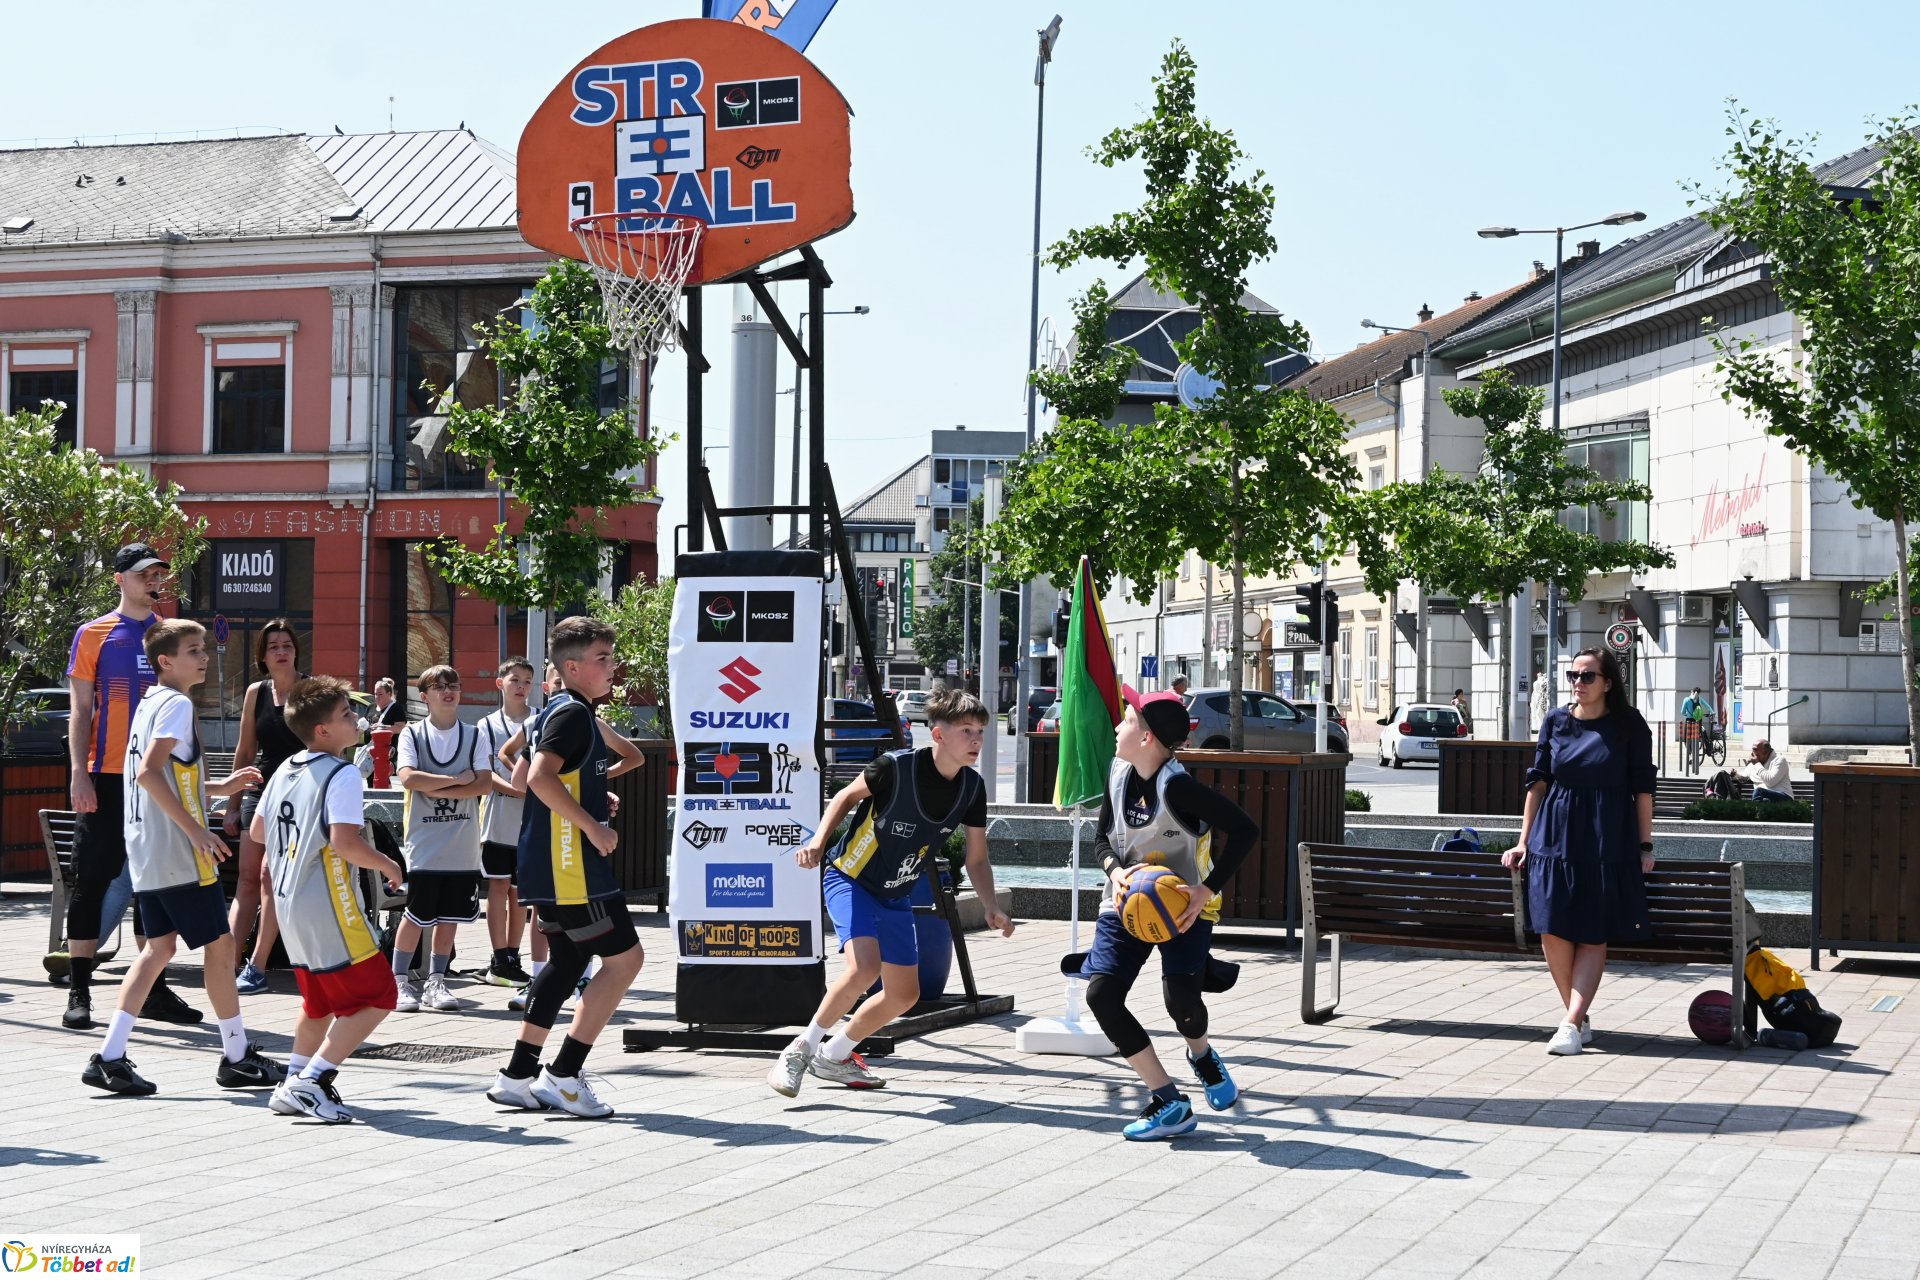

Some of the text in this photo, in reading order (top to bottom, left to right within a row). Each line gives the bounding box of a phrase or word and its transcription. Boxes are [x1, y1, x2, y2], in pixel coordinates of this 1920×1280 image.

[571, 58, 706, 126] STR
[762, 96, 795, 105] MKOSZ
[571, 186, 591, 214] 9
[614, 167, 796, 233] BALL
[741, 314, 752, 322] 36
[264, 509, 441, 534] FASHION
[222, 549, 274, 577] KIADÓ
[902, 561, 914, 634] PALEO
[752, 612, 789, 620] MKOSZ
[689, 710, 790, 729] SUZUKI
[684, 798, 791, 811] STREETBALL
[422, 813, 471, 824] STREETBALL
[690, 826, 728, 844] TOTI
[745, 824, 803, 836] POWER
[713, 874, 765, 888] molten
[747, 891, 765, 899] game
[705, 925, 799, 944] KING OF HOOPS
